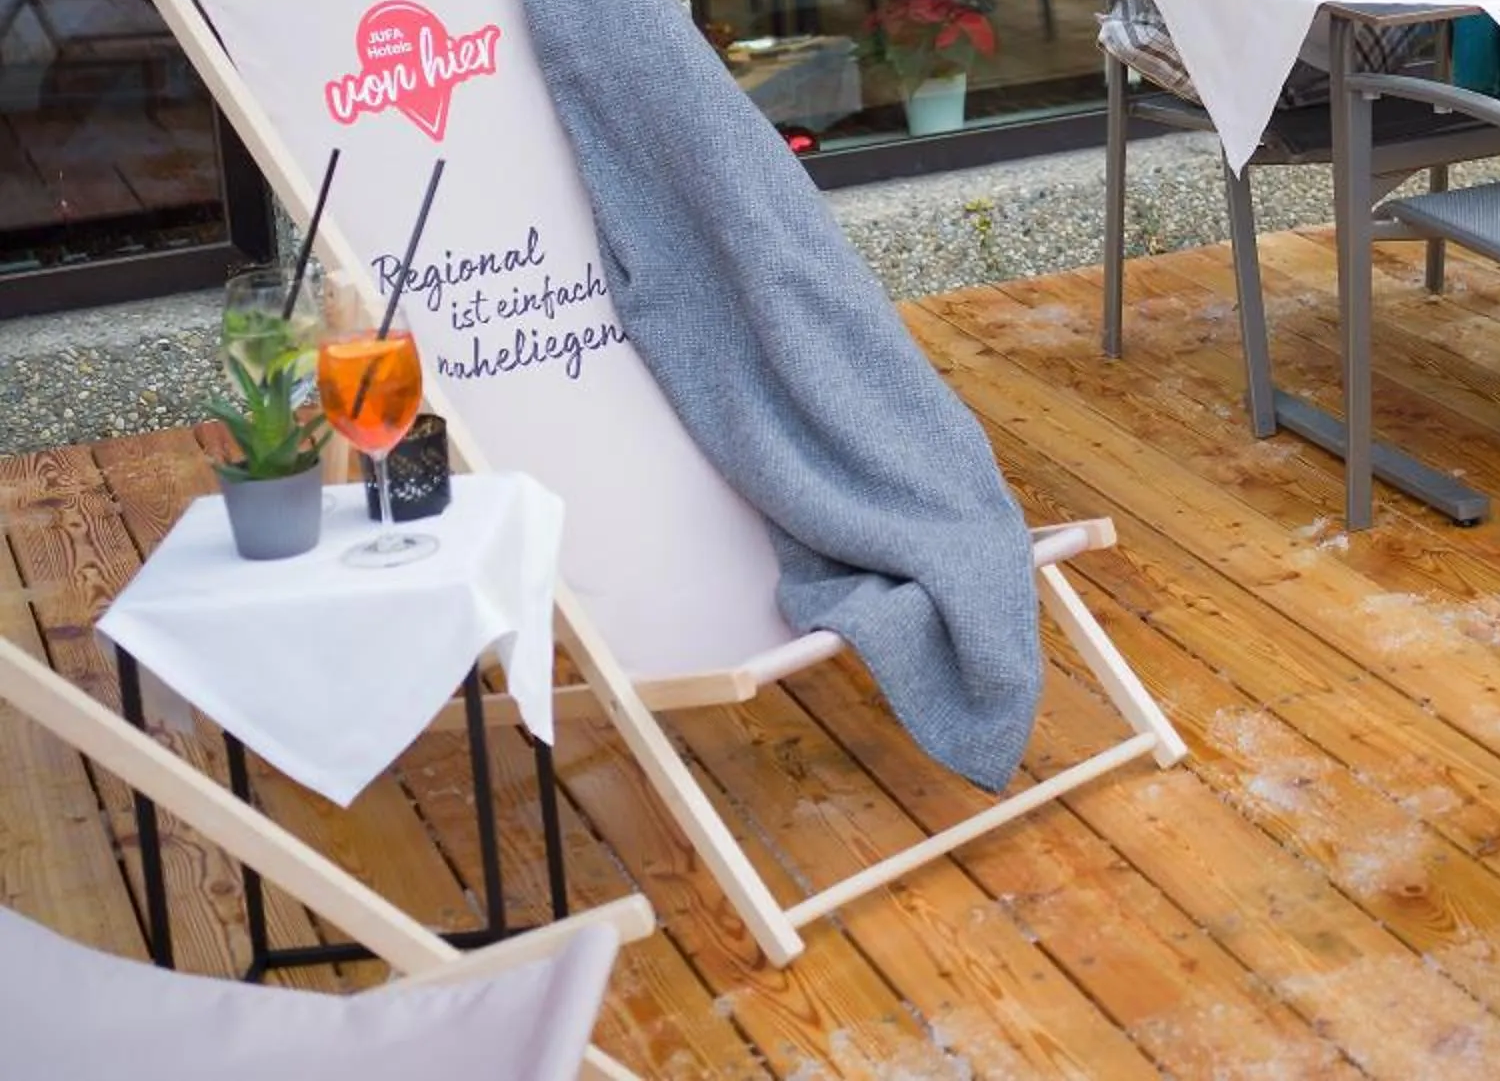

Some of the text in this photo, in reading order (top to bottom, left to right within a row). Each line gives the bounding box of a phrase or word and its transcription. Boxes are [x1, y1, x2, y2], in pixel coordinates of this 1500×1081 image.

[367, 27, 405, 44] JUFA
[367, 40, 414, 59] Hotels
[331, 25, 496, 118] von hier
[371, 226, 545, 312] Regional
[451, 262, 608, 330] ist einfach
[436, 322, 630, 380] naheliegen
